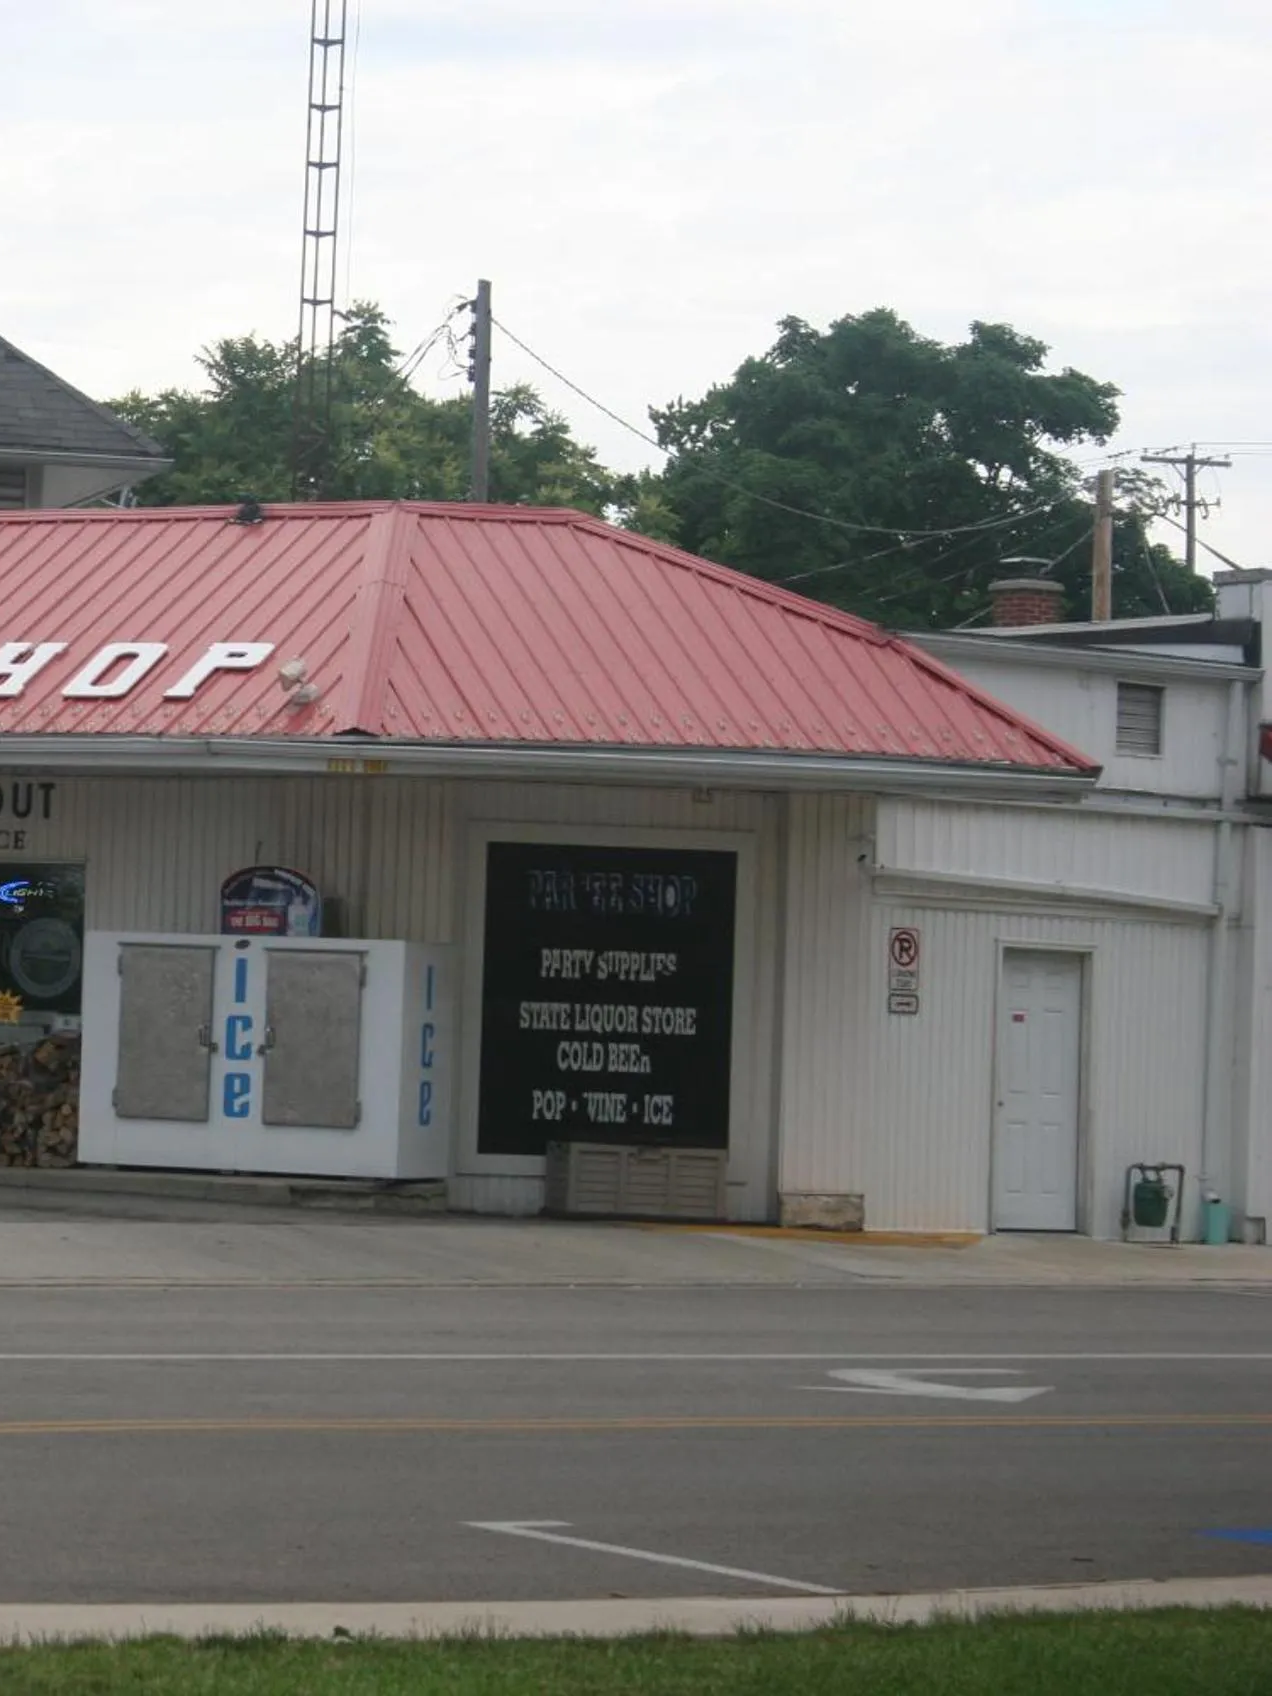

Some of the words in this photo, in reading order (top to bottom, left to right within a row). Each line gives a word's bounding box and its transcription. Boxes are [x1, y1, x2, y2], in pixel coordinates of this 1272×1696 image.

[540, 948, 595, 979] PARTY
[597, 950, 677, 982] SUPPLIES
[519, 1001, 571, 1030] STATE
[574, 1004, 638, 1034] LIQUOR
[641, 1006, 697, 1035] STORE
[557, 1041, 604, 1072] COLD
[532, 1089, 567, 1120] POP
[643, 1094, 674, 1125] ICE
